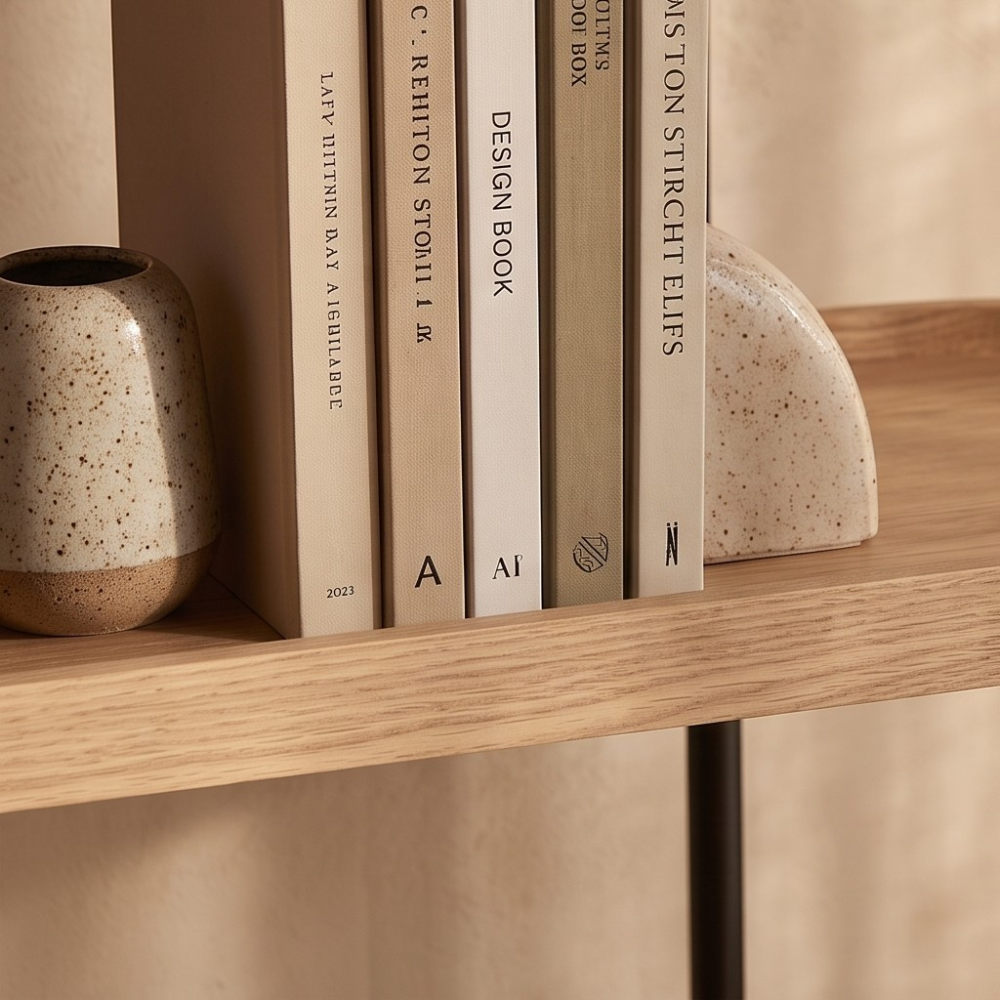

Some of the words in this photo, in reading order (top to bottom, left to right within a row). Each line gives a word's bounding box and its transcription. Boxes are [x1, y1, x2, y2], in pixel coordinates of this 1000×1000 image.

[570, 42, 587, 87] BOX
[411, 54, 431, 185] REHITON
[491, 110, 513, 211] DESIGN
[663, 126, 685, 265] STIRCHT
[492, 220, 514, 298] BOOK
[662, 273, 684, 356] ELIFS
[326, 585, 355, 599] 2023
[414, 555, 442, 589] A
